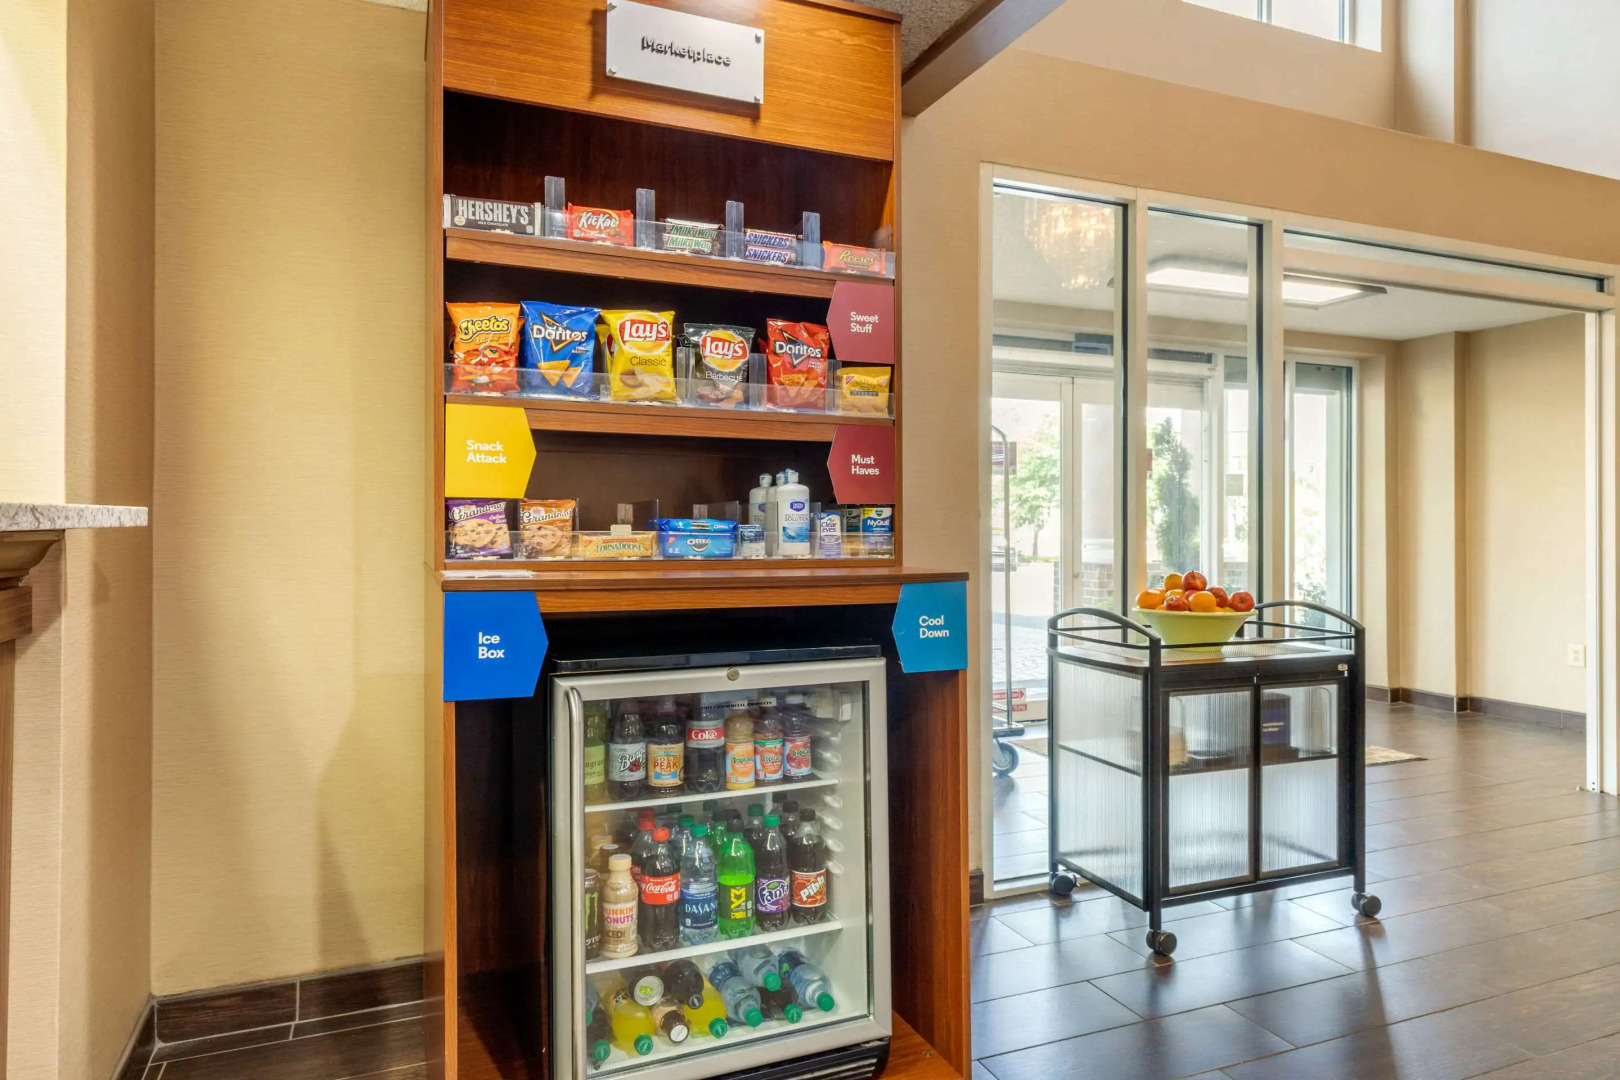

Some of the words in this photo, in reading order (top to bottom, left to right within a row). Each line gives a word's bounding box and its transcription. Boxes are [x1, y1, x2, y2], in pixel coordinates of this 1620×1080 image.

[640, 35, 733, 67] Marketplace
[458, 196, 529, 225] HERSHEY'S
[746, 232, 790, 248] SNICKERS
[746, 248, 789, 263] SNICKERS
[850, 311, 879, 323] Sweet
[459, 315, 511, 342] Cheetos
[532, 324, 588, 342] Doritos
[850, 322, 873, 334] Stuff
[775, 341, 822, 358] Doritos
[629, 356, 667, 367] Classic
[466, 439, 504, 452] Snack
[466, 451, 507, 464] Attack
[851, 454, 875, 464] Must
[851, 464, 880, 475] Haves
[867, 519, 890, 528] NyQuil
[919, 614, 944, 627] Cool
[478, 632, 501, 645] Ice
[919, 627, 950, 639] Down
[478, 646, 505, 659] Box
[691, 729, 718, 741] Coke
[653, 761, 679, 770] PEAK
[645, 880, 677, 894] Coca-Cola
[758, 883, 789, 905] Fanta
[685, 901, 718, 916] DASAN
